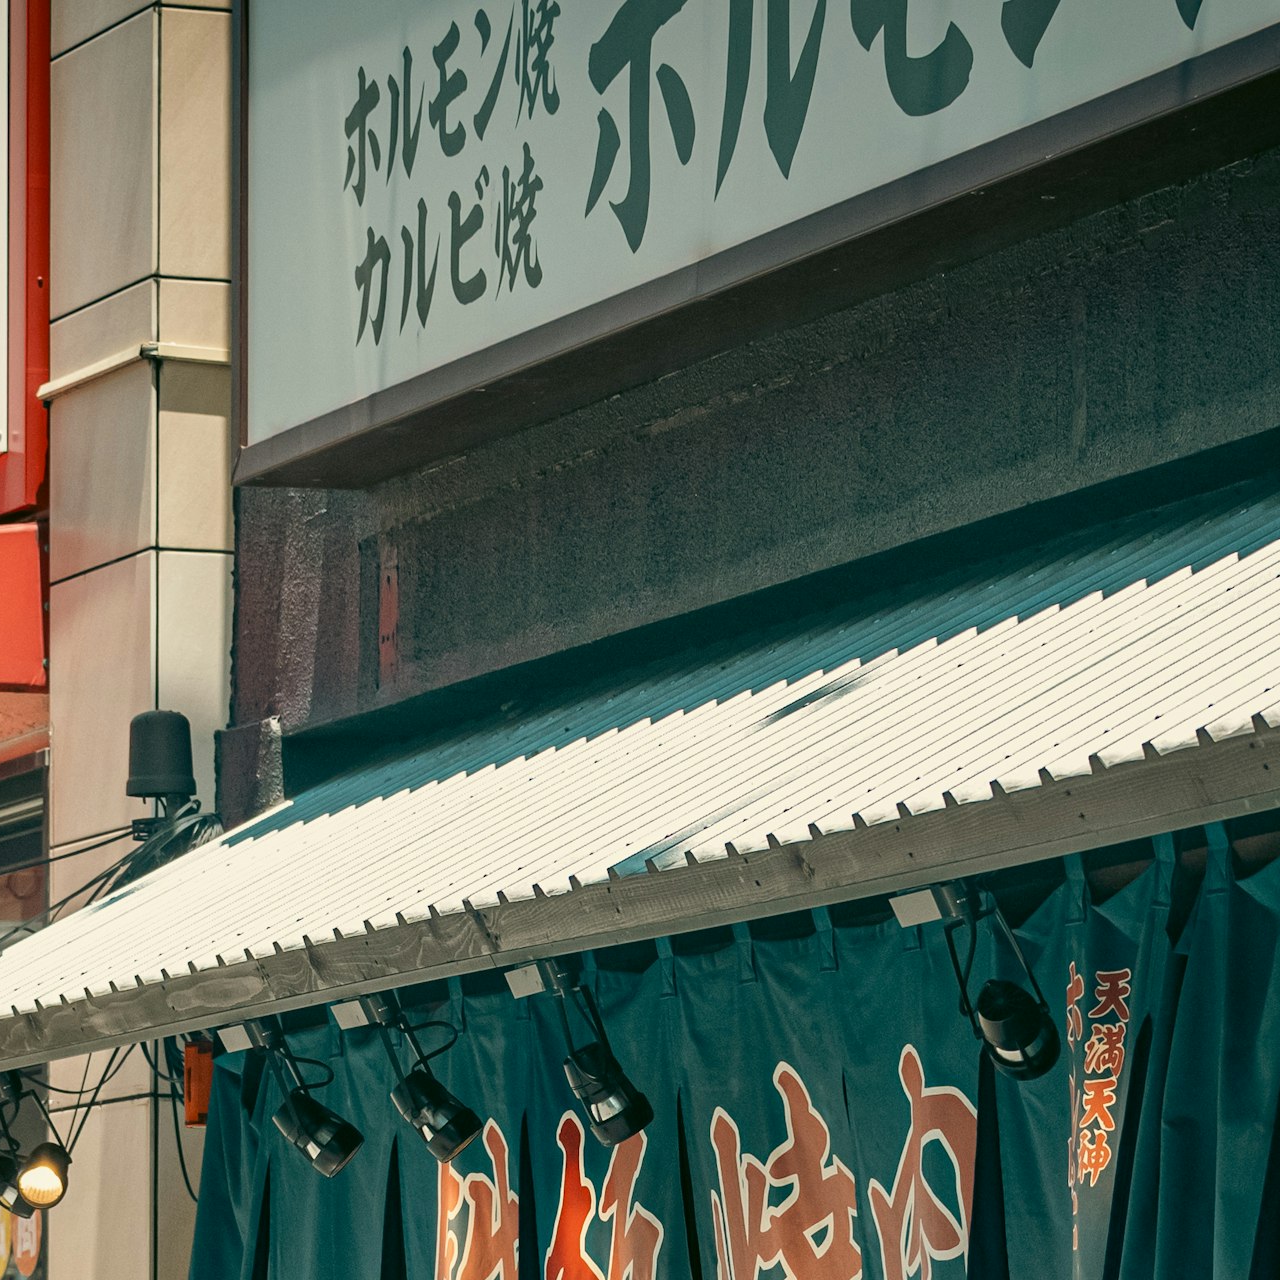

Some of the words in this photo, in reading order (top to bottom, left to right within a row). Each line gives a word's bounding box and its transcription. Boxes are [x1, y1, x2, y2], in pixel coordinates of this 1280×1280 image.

[342, 0, 560, 206] ホルモン焼
[354, 142, 544, 346] カルビ焼
[1076, 967, 1132, 1188] 天満天神
